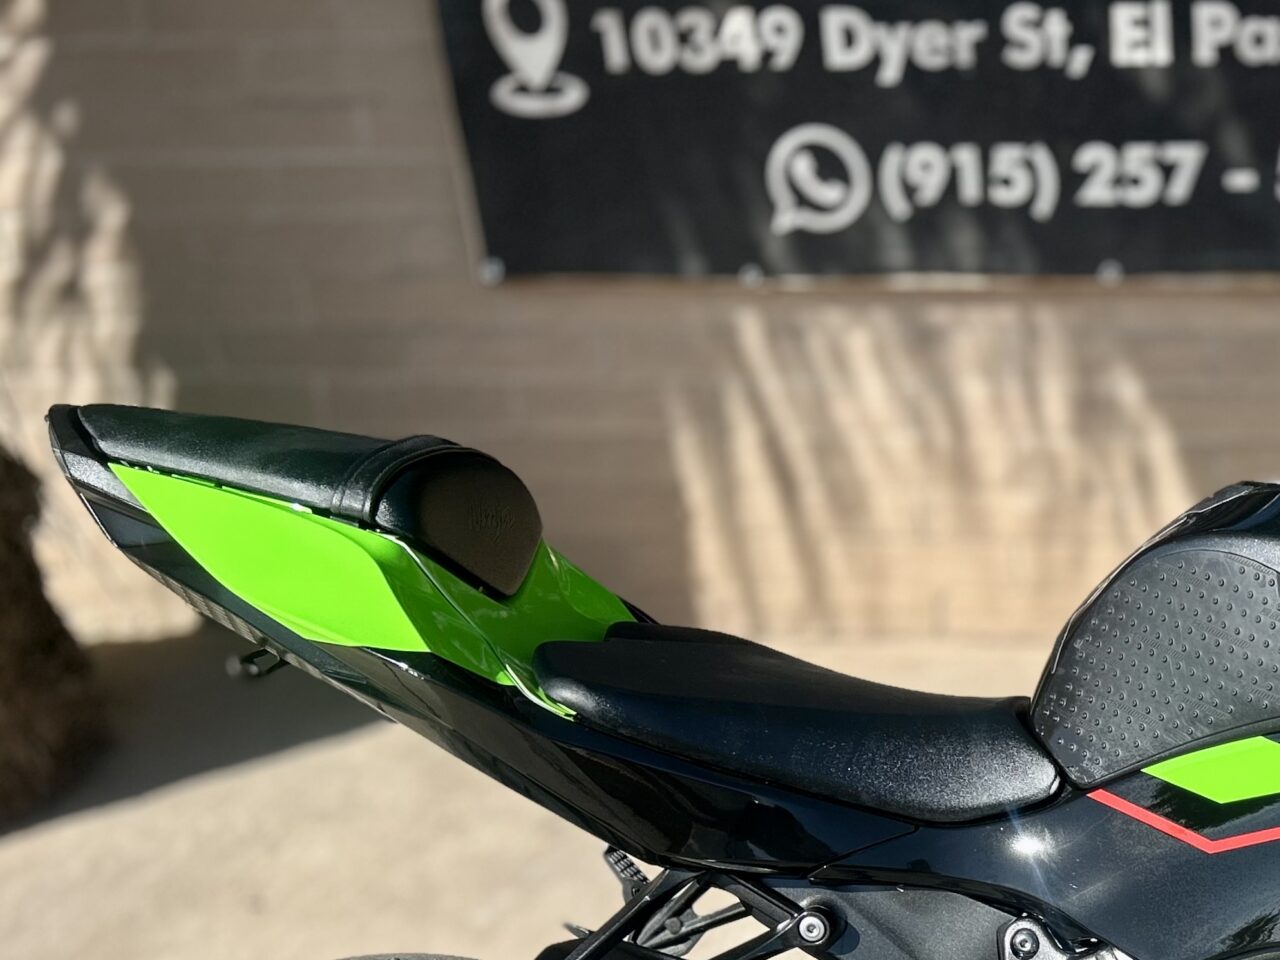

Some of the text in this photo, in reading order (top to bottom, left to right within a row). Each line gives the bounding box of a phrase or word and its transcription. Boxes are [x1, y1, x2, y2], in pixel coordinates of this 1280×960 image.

[593, 5, 804, 75] 10349
[819, 7, 988, 88] Dyer
[1001, 3, 1095, 79] St,
[1108, 1, 1174, 67] El
[878, 141, 1061, 222] (915)
[1072, 140, 1208, 208] 257
